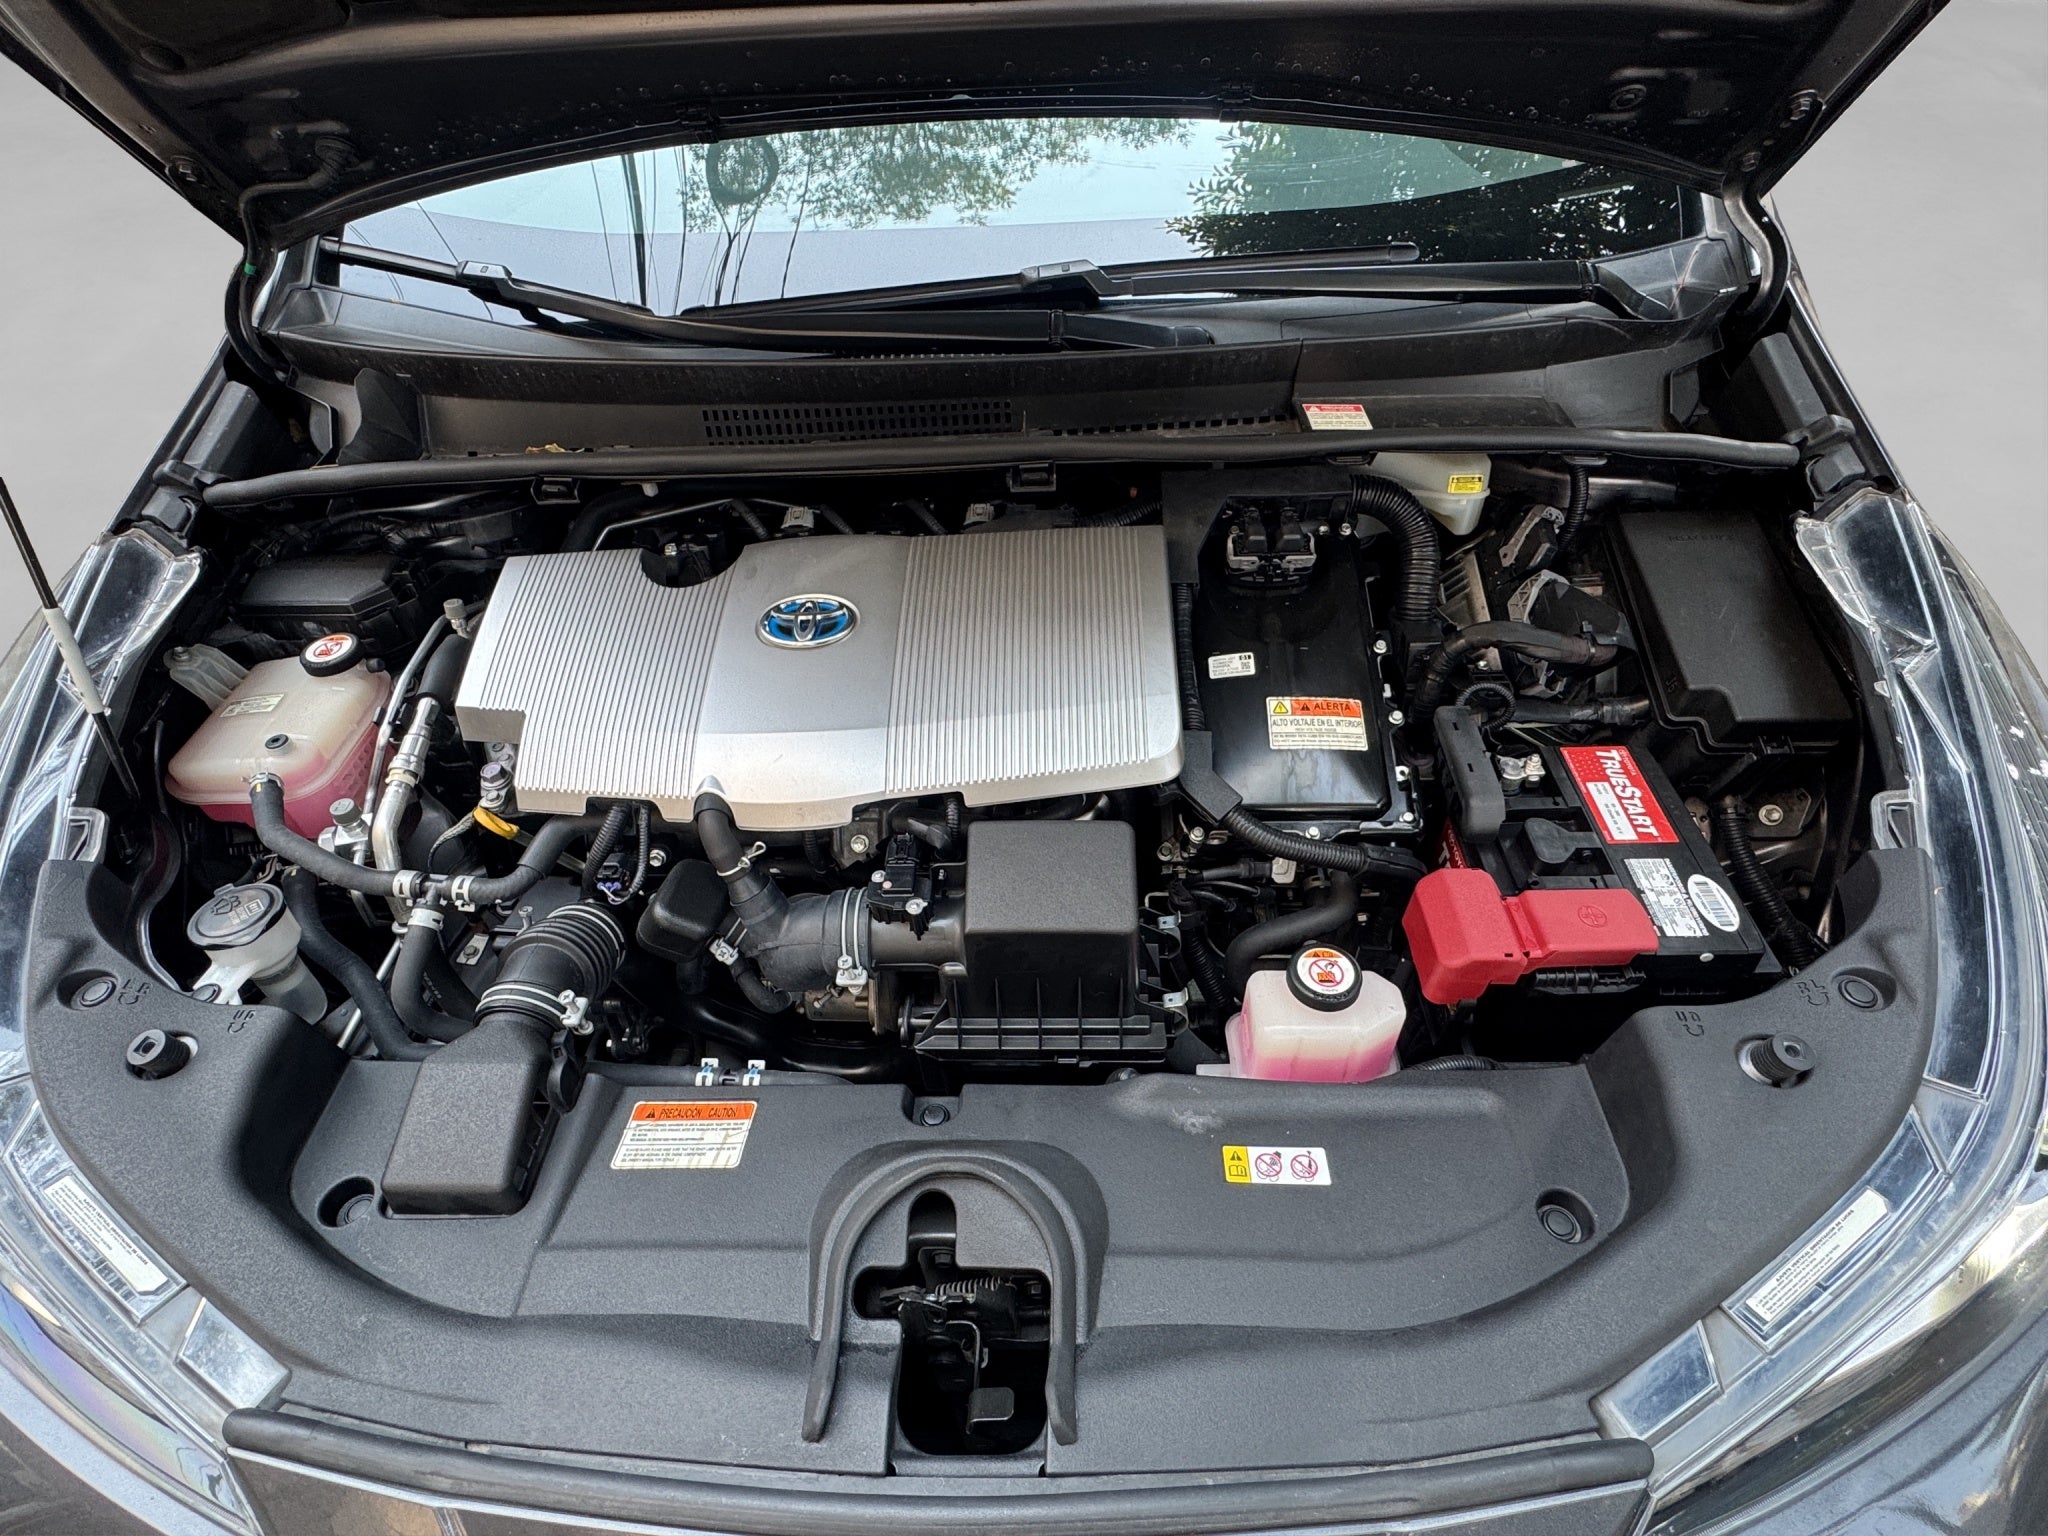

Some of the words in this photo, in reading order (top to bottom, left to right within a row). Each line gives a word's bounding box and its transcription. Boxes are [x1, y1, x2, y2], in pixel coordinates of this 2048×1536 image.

[1314, 702, 1351, 711] ALERTA
[1272, 718, 1288, 727] ALTO
[1289, 718, 1316, 727] VOLTAJE
[1317, 718, 1325, 727] EN
[1326, 718, 1335, 727] EL
[707, 1106, 738, 1119] CAUTION
